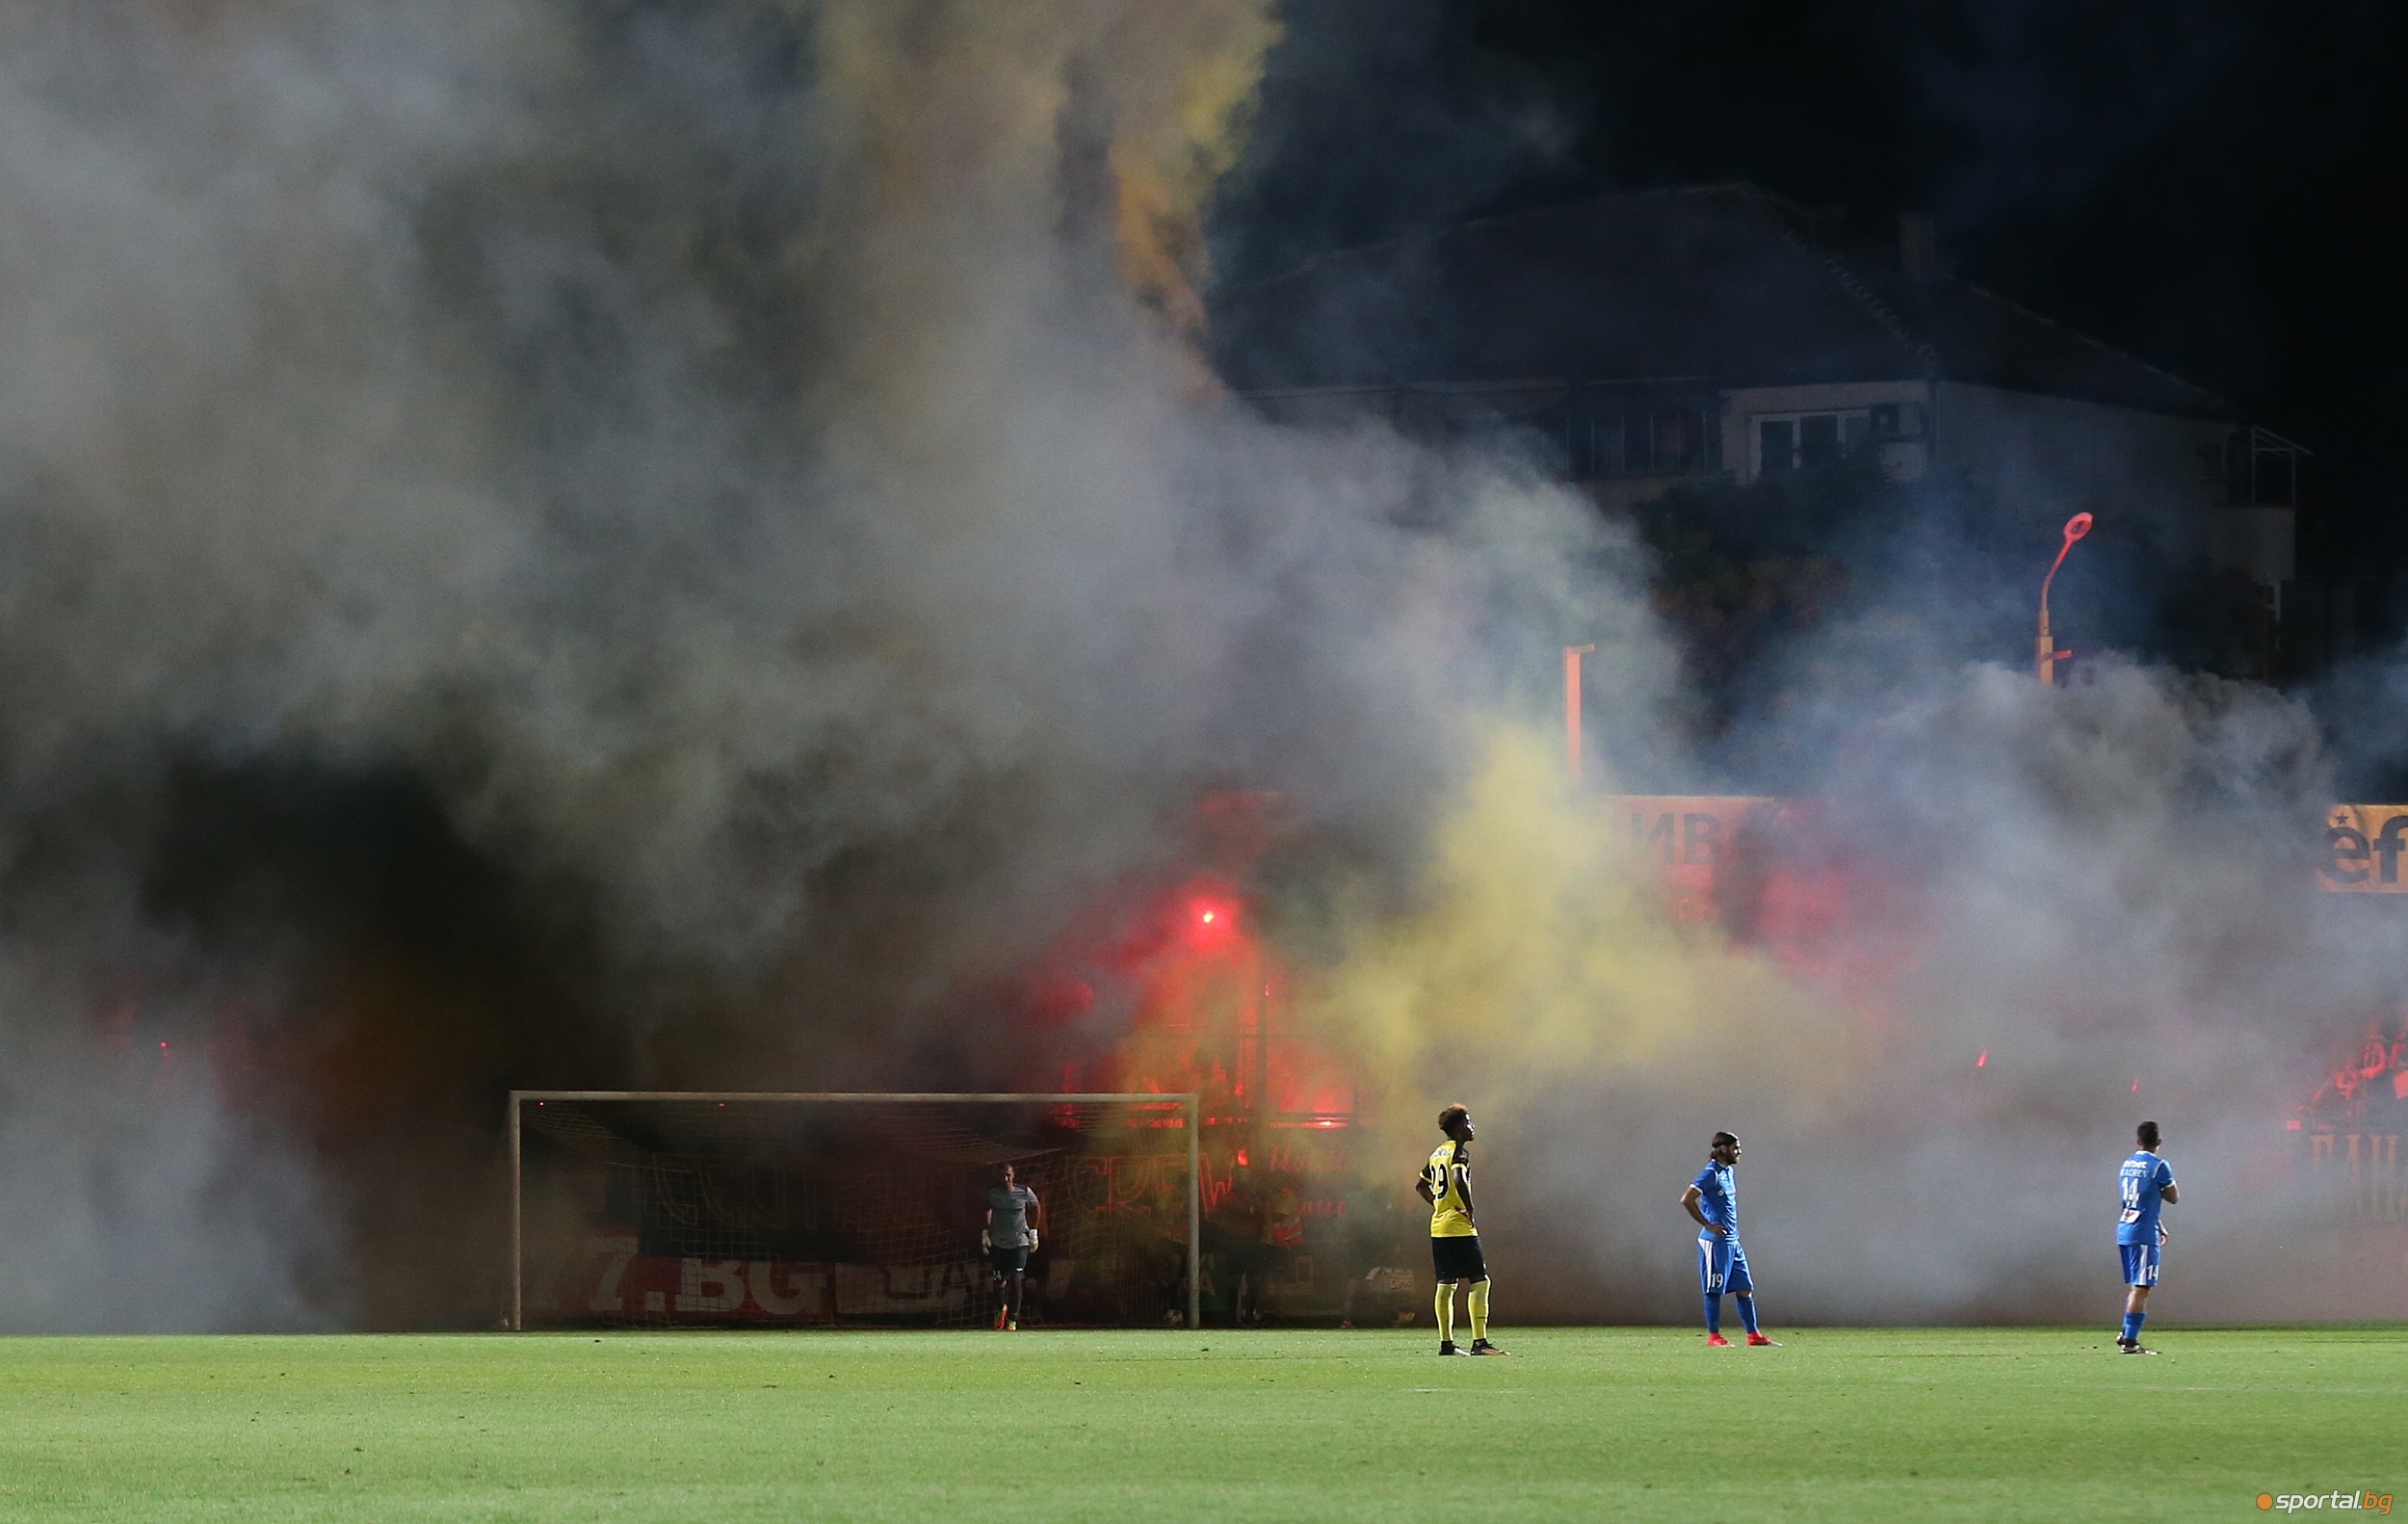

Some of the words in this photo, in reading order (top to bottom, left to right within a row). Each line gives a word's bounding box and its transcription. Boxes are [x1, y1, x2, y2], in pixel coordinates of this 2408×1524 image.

[2122, 1176, 2140, 1208] 14
[1711, 1273, 1724, 1289] 19
[2147, 1264, 2159, 1281] 14
